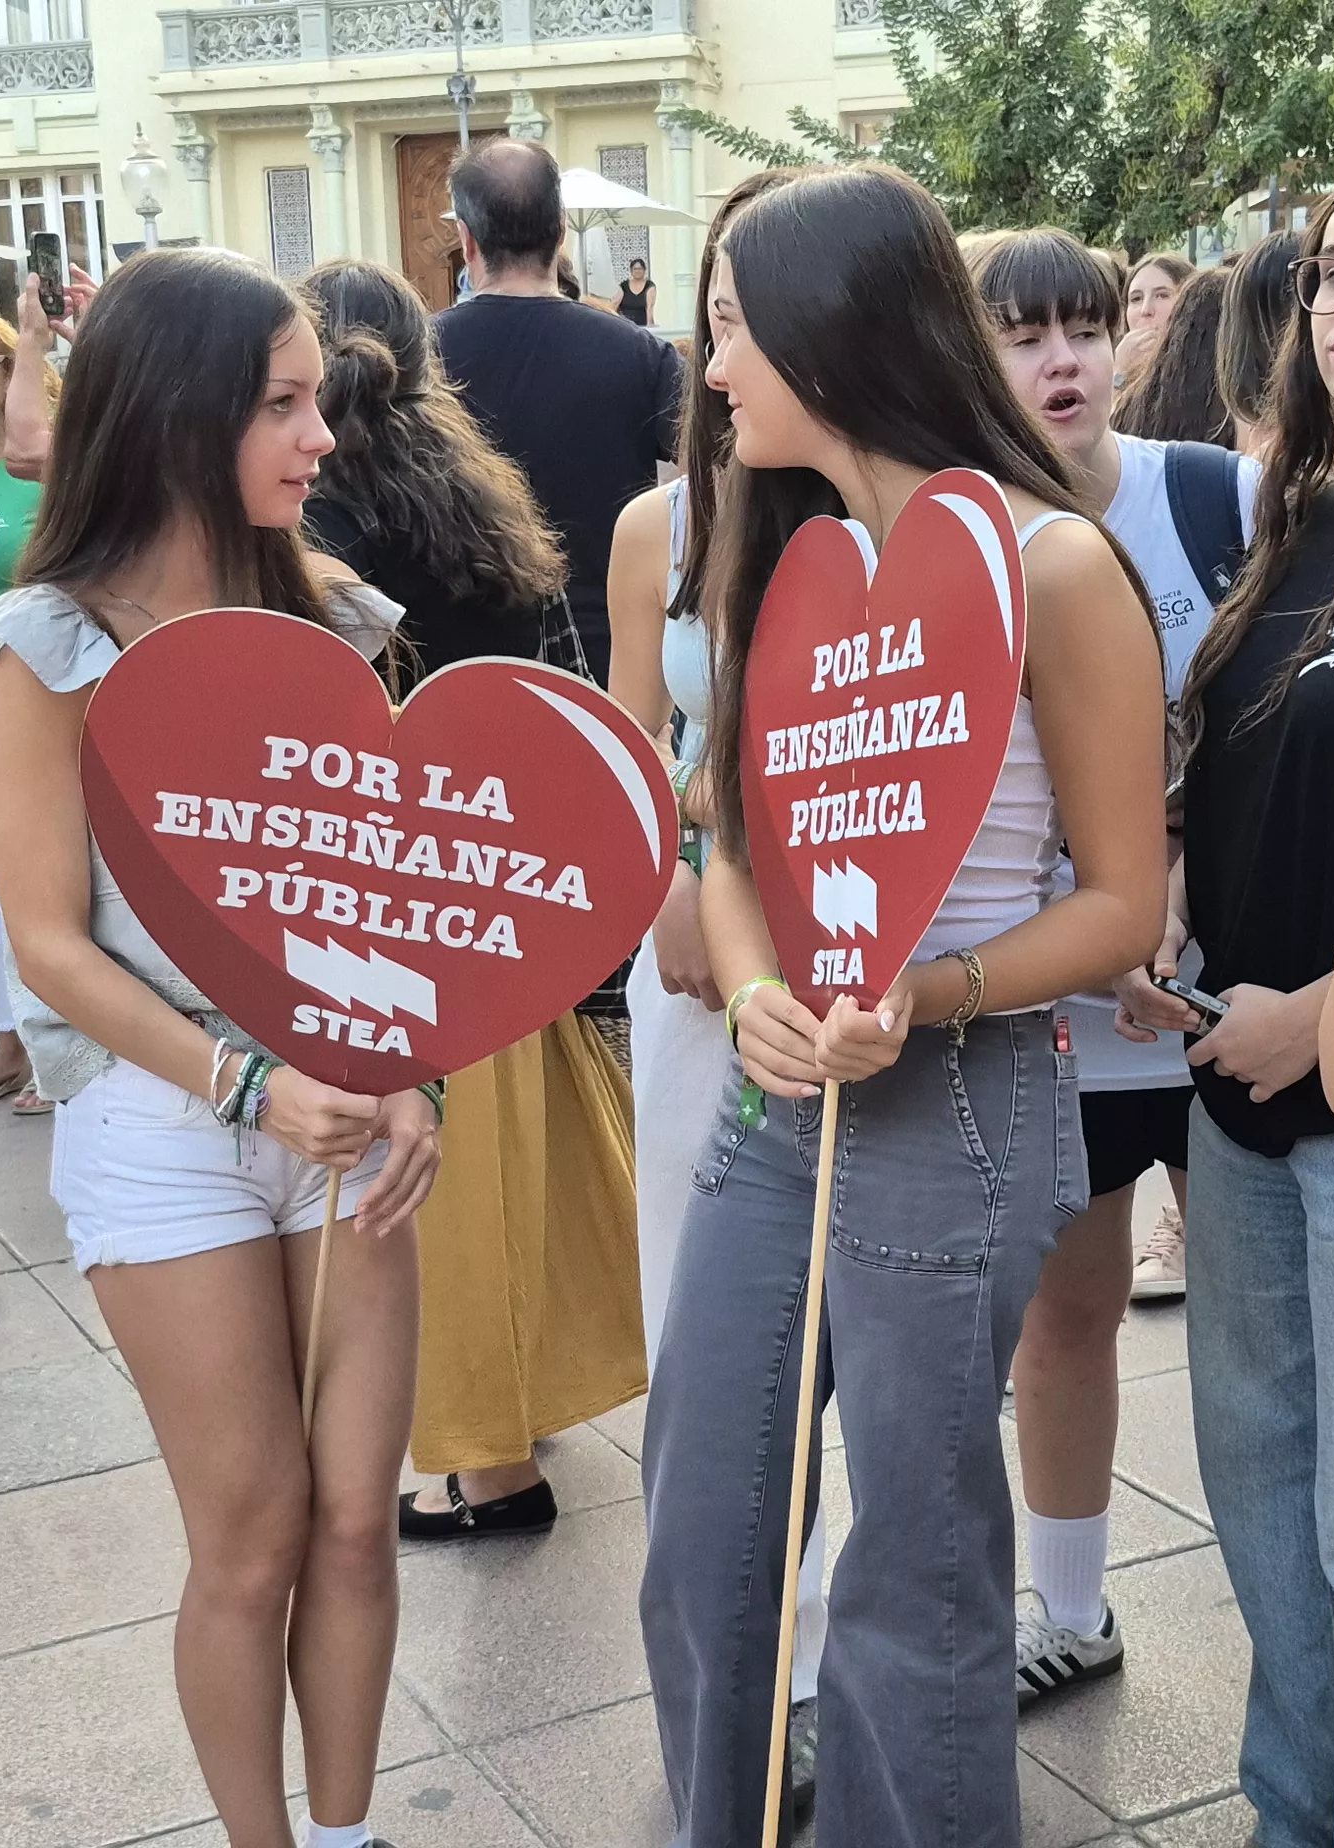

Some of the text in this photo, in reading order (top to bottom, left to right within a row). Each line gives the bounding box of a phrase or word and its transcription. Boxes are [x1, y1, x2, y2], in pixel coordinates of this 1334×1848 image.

[811, 617, 925, 693] POR LA
[765, 691, 969, 776] ENSEÑANZA
[261, 735, 514, 822] POR LA
[788, 780, 926, 847] PÚBLICA
[153, 791, 593, 911] ENSEÑANZA
[216, 862, 524, 960] PÚBLICA
[812, 948, 865, 986] STEA
[291, 1004, 413, 1057] STEA
